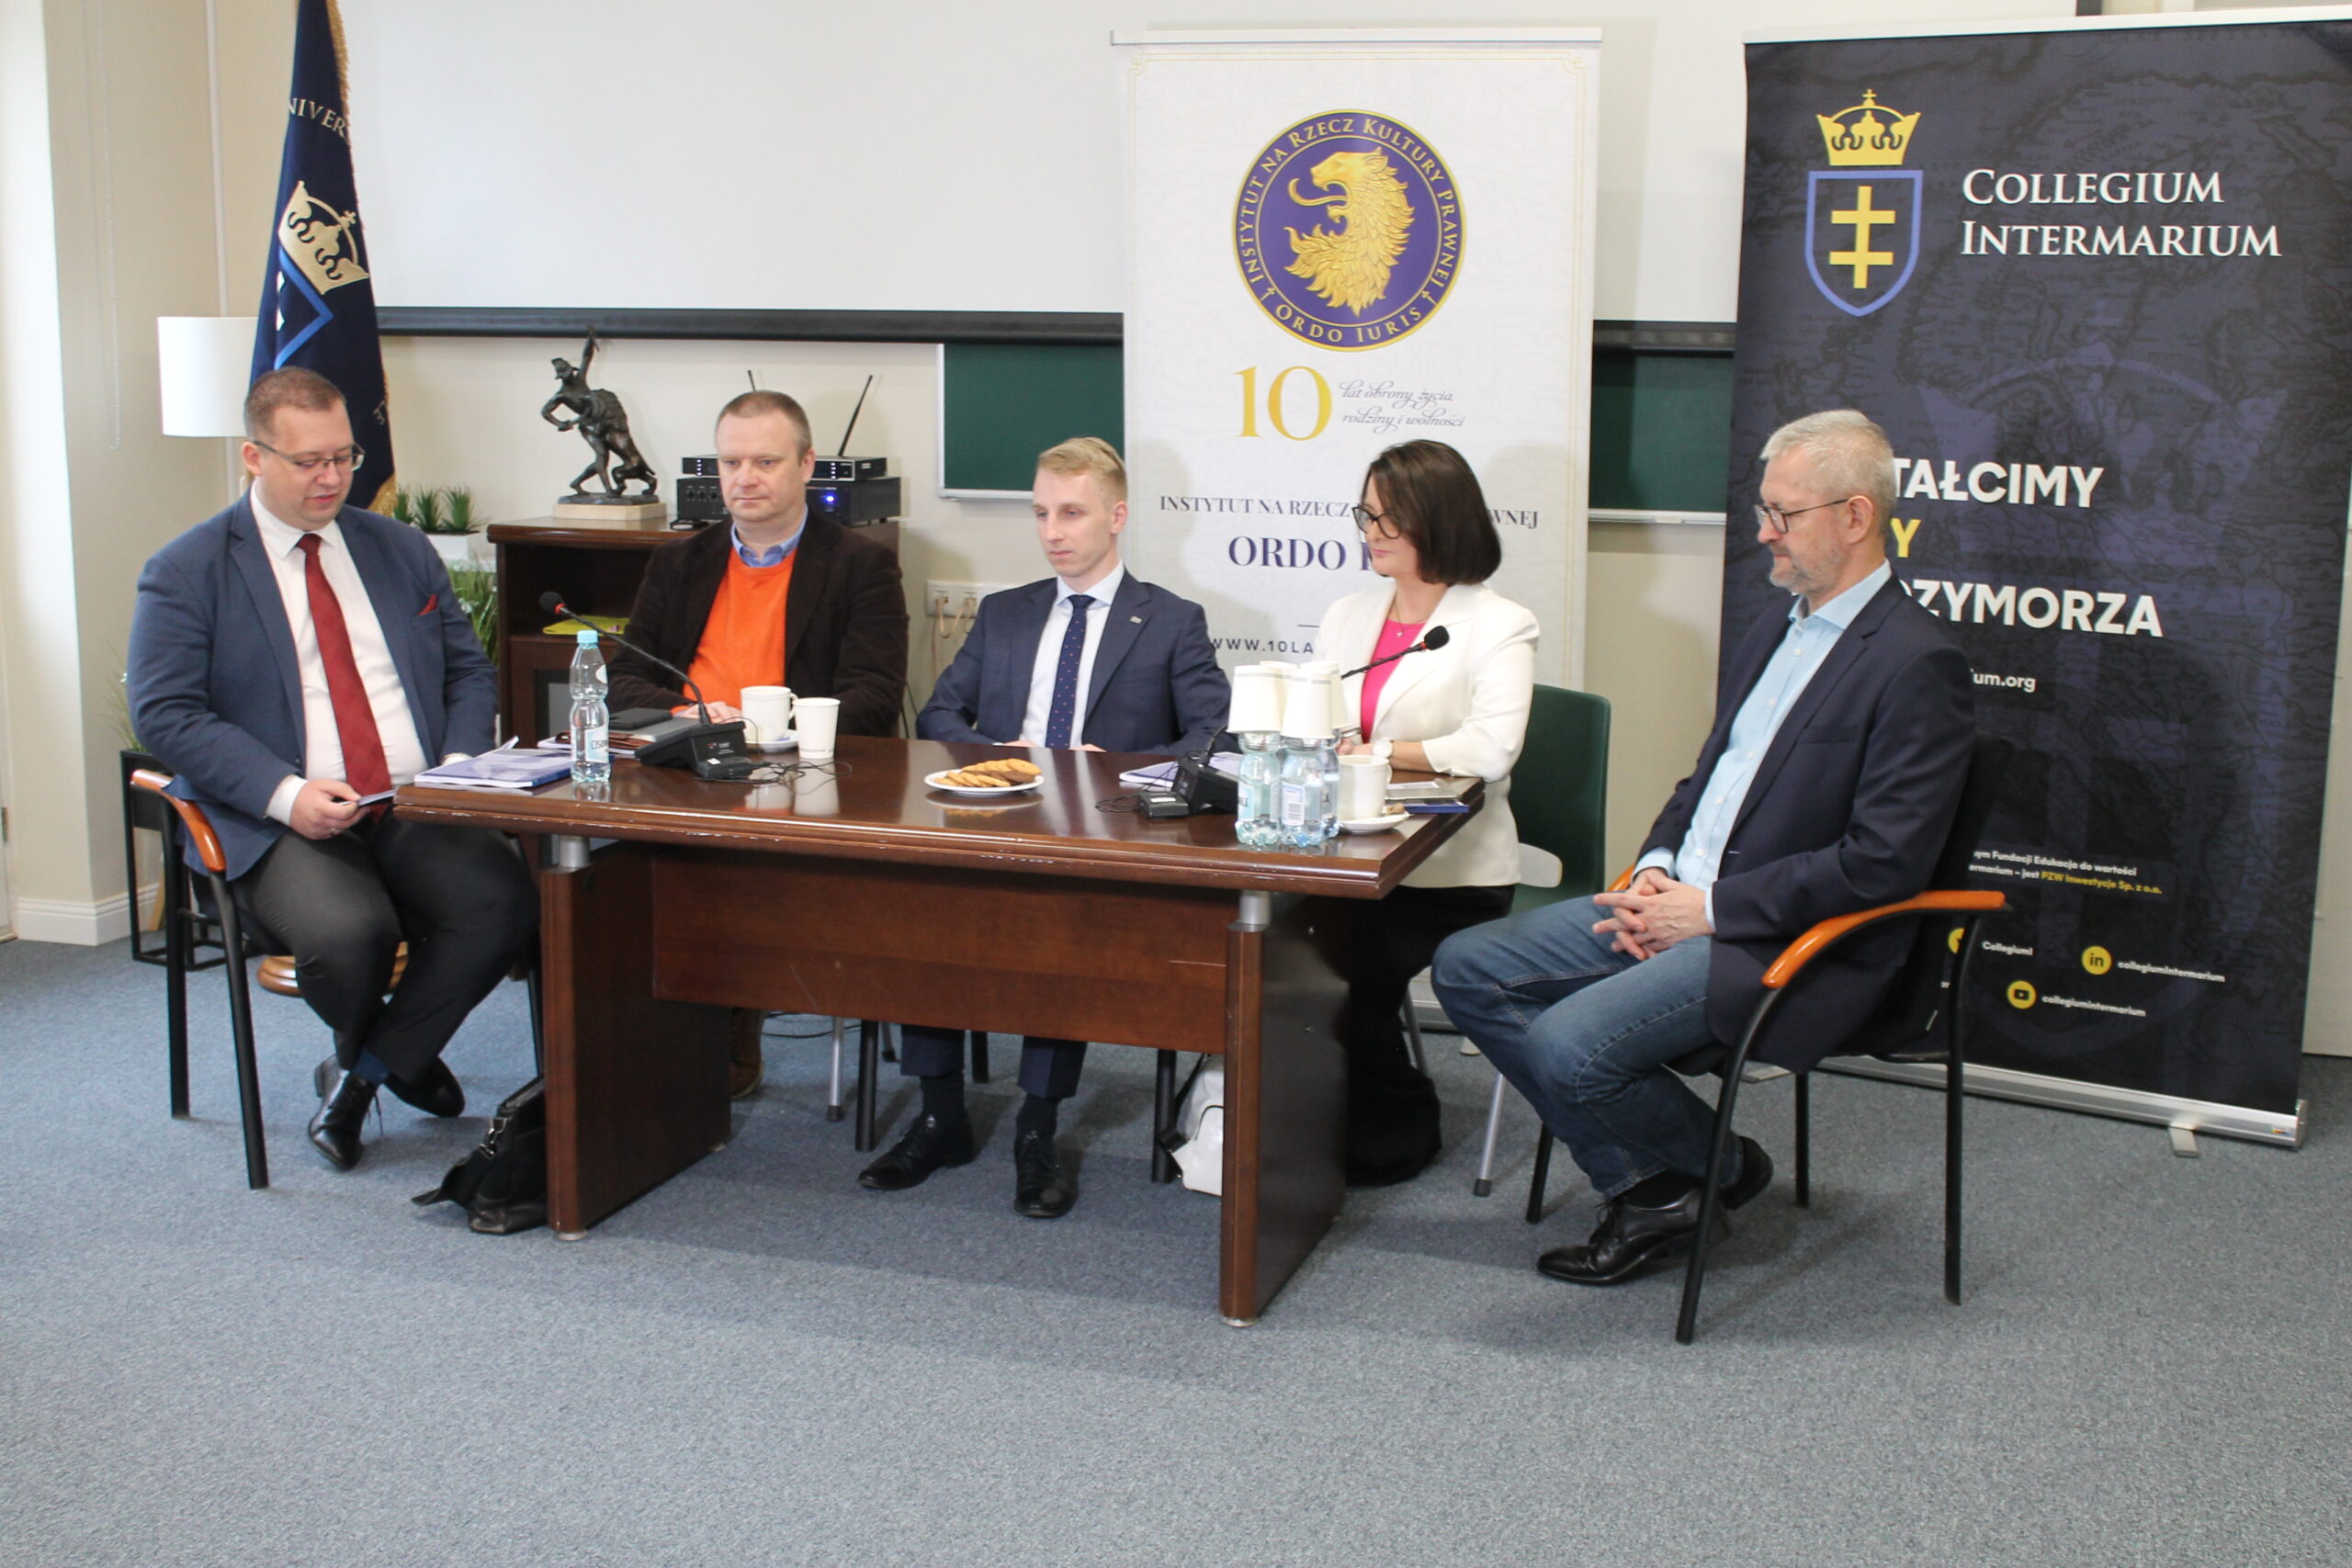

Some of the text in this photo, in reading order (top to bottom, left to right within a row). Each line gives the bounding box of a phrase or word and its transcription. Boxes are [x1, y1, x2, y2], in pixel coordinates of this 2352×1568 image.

[1240, 118, 1458, 288] INSTYTUT NA RZECZ KULTURY PRAWNEJ
[1962, 169, 2224, 205] COLLEGIUM
[1961, 220, 2282, 256] INTERMARIUM
[1275, 304, 1422, 343] ORDO IURIS
[1233, 366, 1332, 441] 10
[1339, 379, 1454, 410] lat obrony życia
[1341, 406, 1465, 434] rodziny i wolności
[1160, 495, 1253, 513] INSTYTUT
[1258, 499, 1283, 514] NA
[1289, 501, 1351, 517] RZECZ
[1228, 536, 1347, 570] ORDO
[1899, 579, 2163, 637] ZYMORZA
[1971, 669, 2036, 693] um.org
[1992, 850, 2032, 864] Fundacji
[2079, 862, 2092, 871] do
[2020, 869, 2040, 879] jest
[2041, 871, 2064, 882] PZW
[2119, 880, 2134, 892] Sp.
[2143, 886, 2162, 895] o.o.
